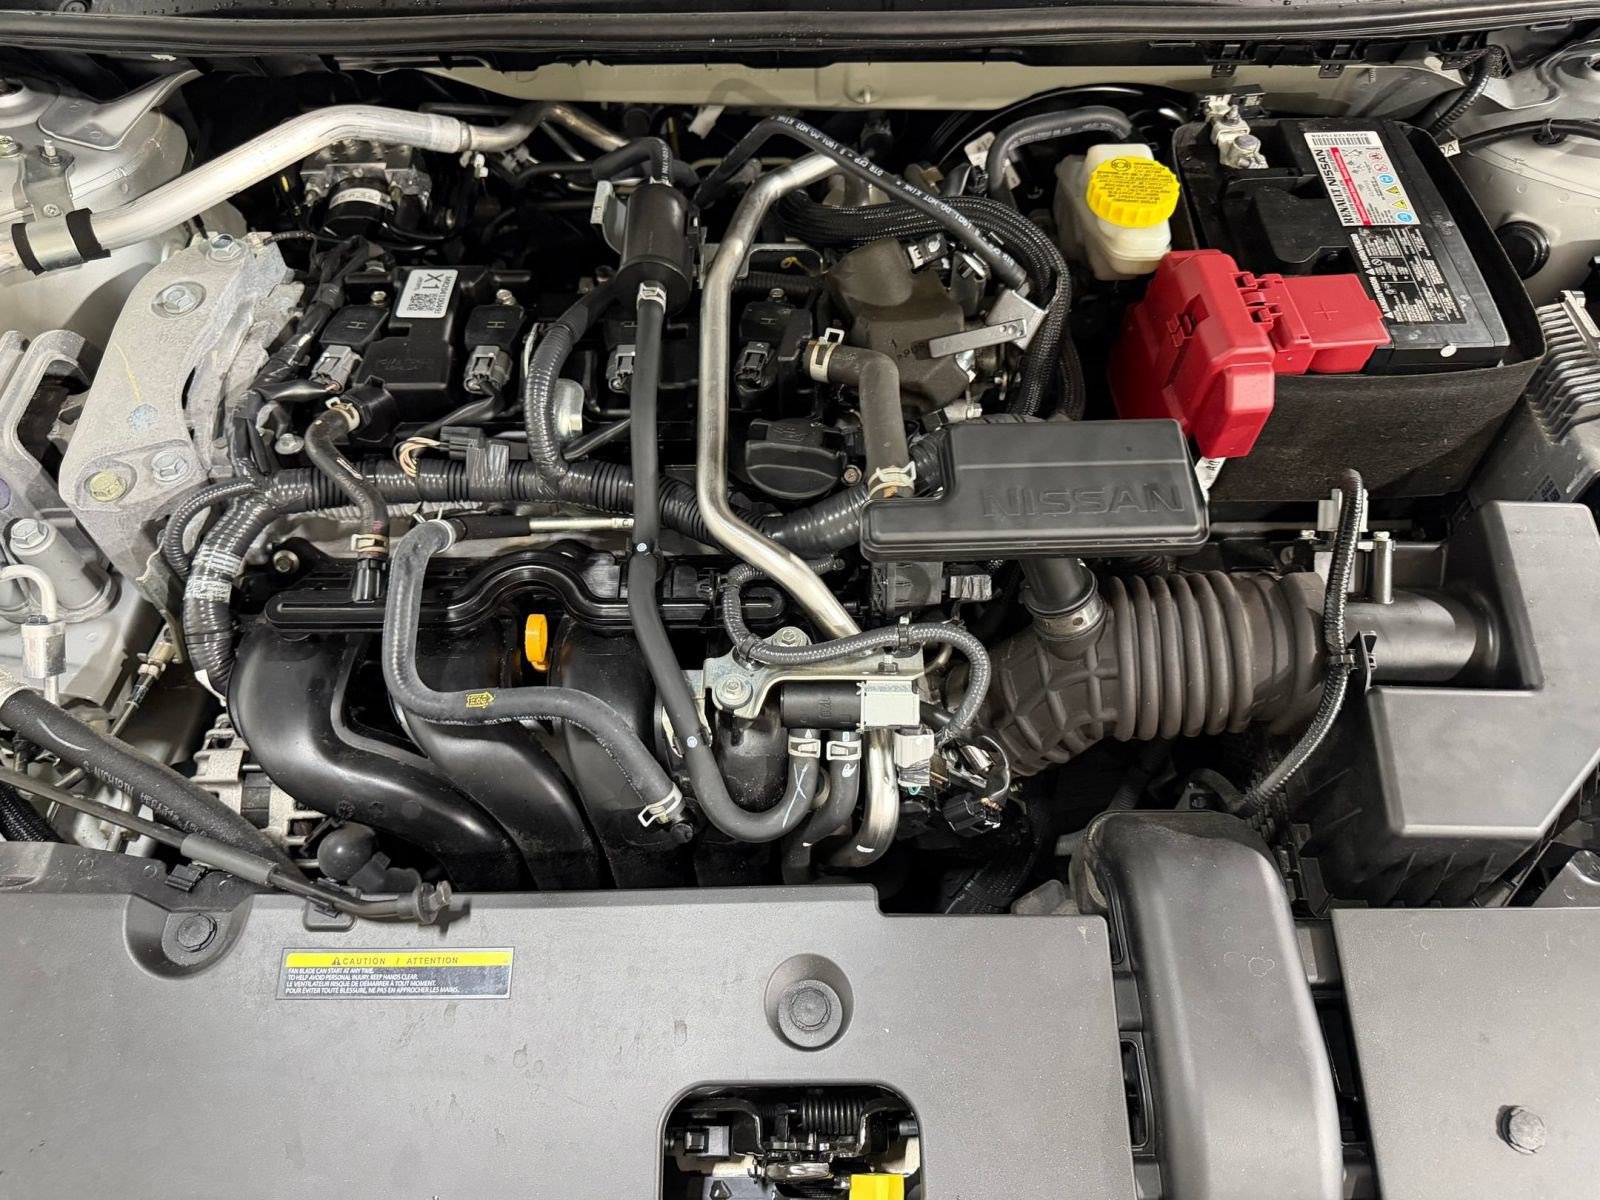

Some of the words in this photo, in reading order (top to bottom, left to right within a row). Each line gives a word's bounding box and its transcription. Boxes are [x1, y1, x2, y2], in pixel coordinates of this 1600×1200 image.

[1314, 149, 1337, 187] NISSAN
[1332, 188, 1355, 224] RENAULT
[422, 273, 444, 289] X1
[981, 482, 1185, 518] NISSAN
[342, 957, 386, 966] CAUTION
[406, 957, 459, 965] ATTENTION
